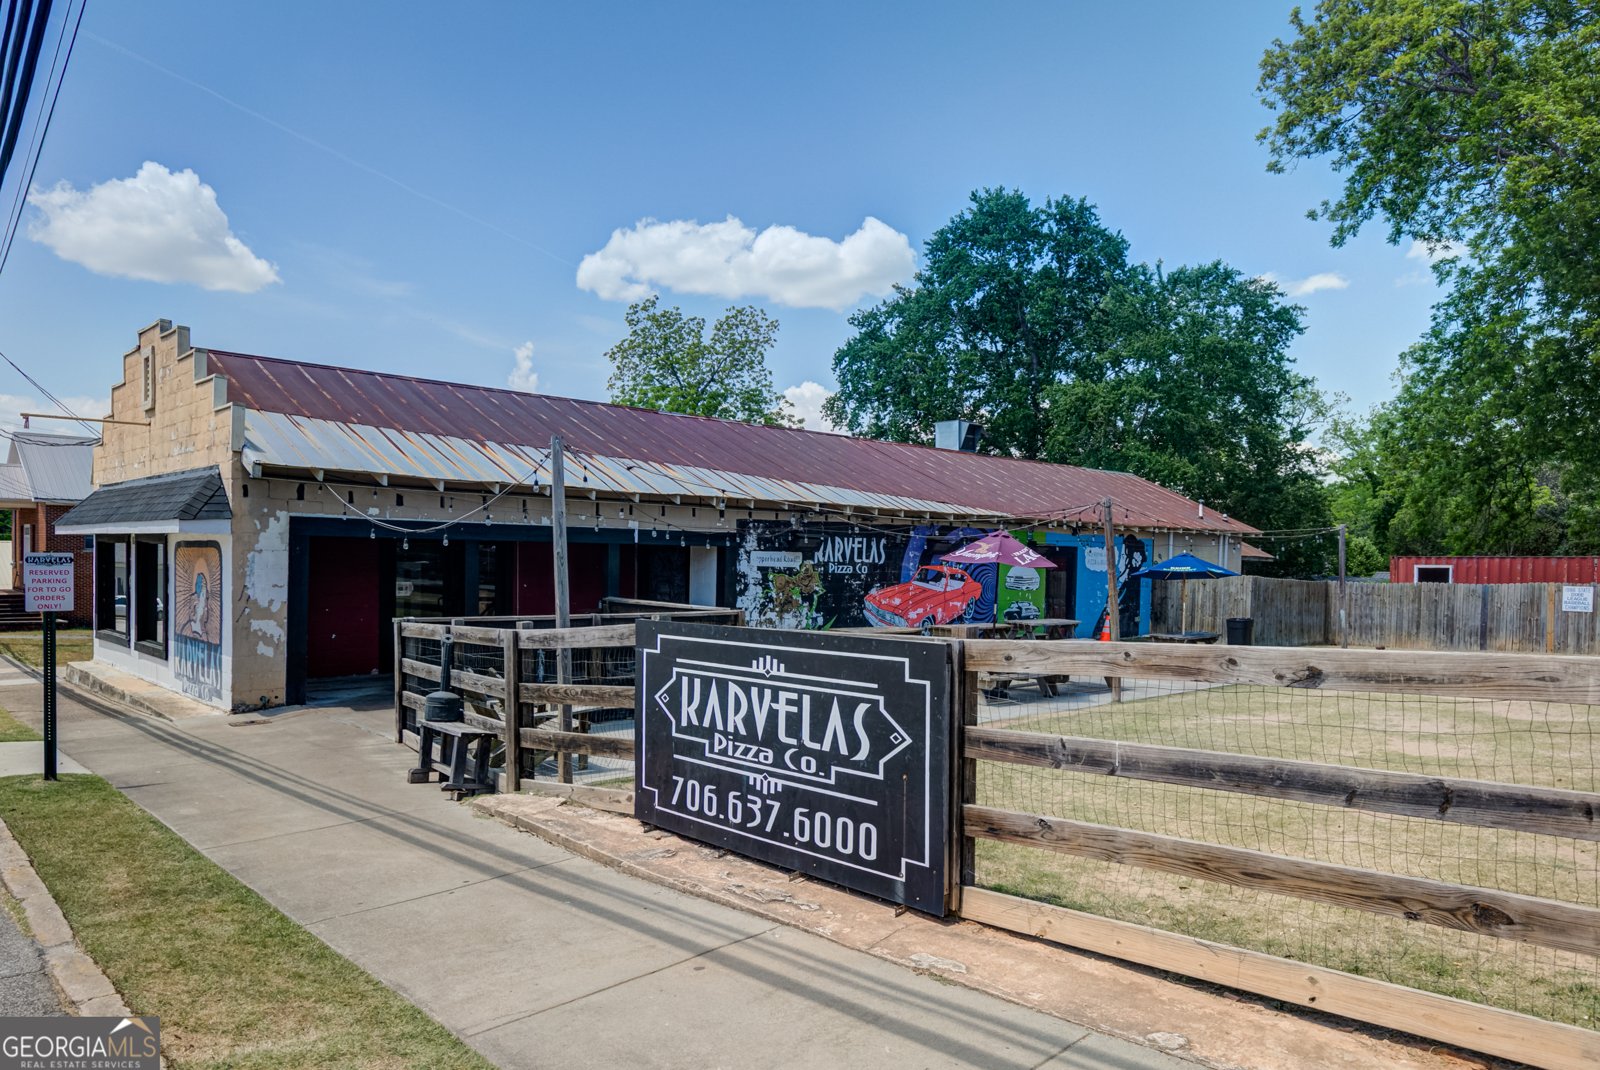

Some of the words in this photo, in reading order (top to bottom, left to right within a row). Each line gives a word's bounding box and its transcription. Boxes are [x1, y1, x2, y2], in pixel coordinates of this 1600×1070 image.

[829, 563, 853, 574] Pizza
[856, 563, 868, 574] Co
[175, 636, 222, 690] KARVELAS
[681, 676, 872, 761] KARVELAS
[714, 732, 774, 766] Pizza
[784, 748, 825, 776] Co.
[671, 775, 878, 861] 706.637.6000
